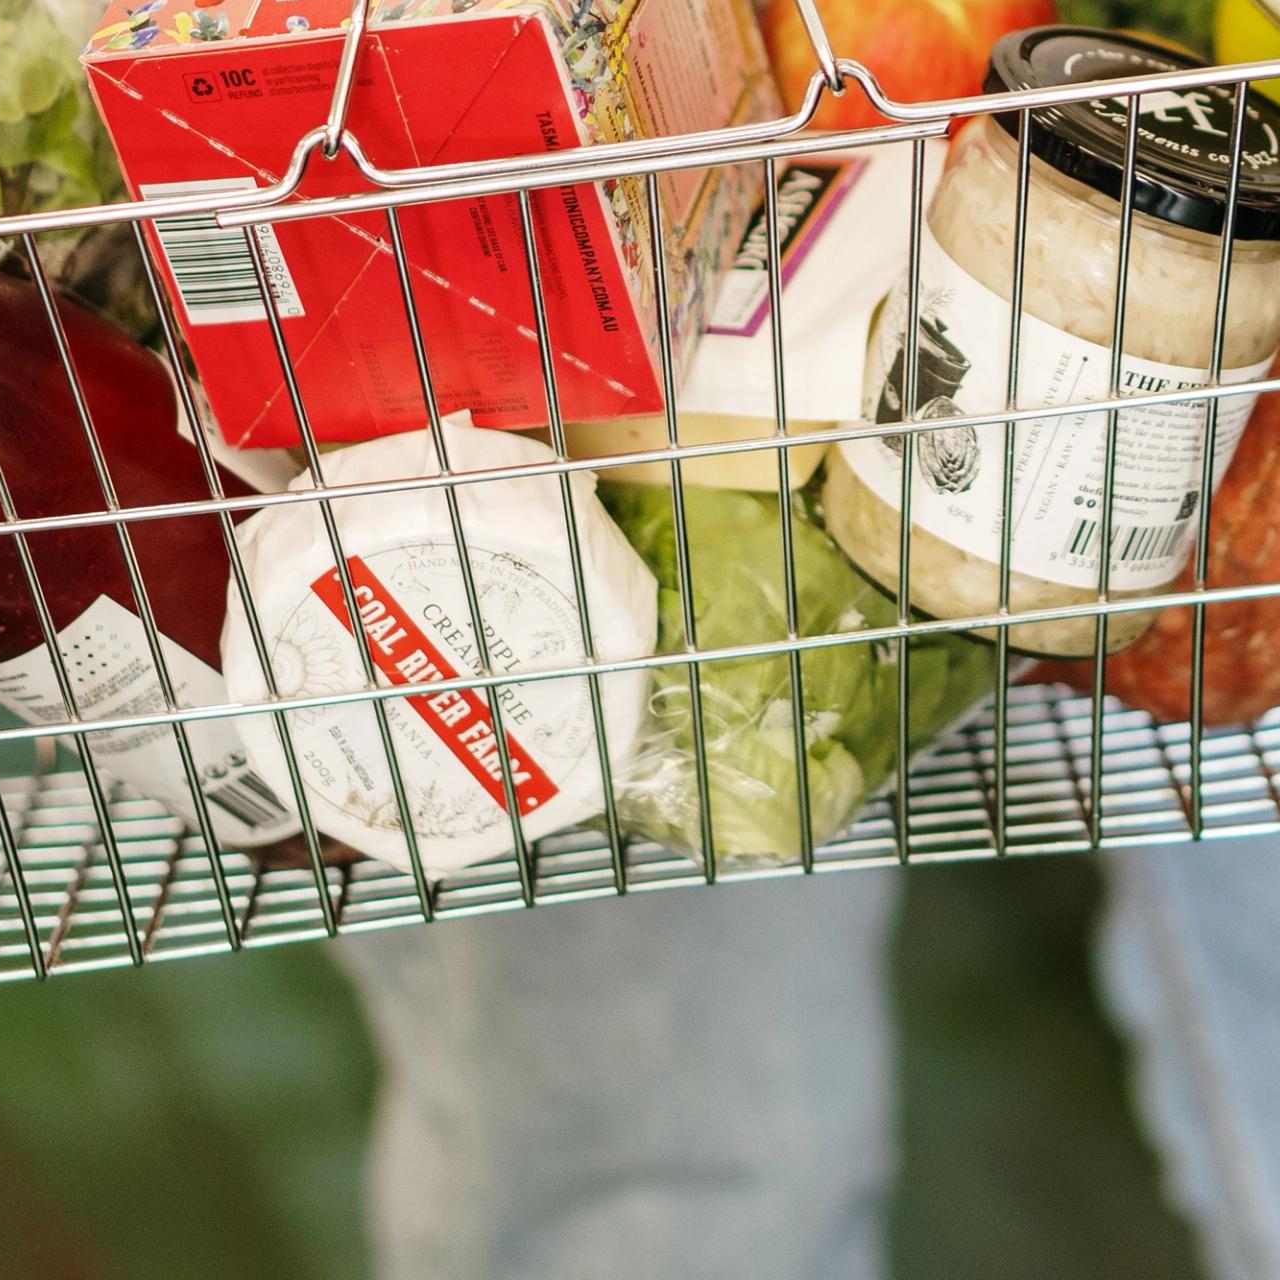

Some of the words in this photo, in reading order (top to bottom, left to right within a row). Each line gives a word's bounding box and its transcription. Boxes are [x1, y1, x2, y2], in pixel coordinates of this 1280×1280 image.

[219, 68, 257, 88] 10C
[228, 88, 264, 100] REFUND
[1094, 109, 1200, 157] fements
[536, 110, 620, 332] TASMTONICCOMPANY.COM.AU
[1016, 383, 1058, 473] PRESERVIVE
[1053, 352, 1072, 383] FREE
[1035, 482, 1059, 521] VEGAN
[1057, 442, 1074, 470] RAW
[1073, 394, 1095, 430] ALE
[1078, 484, 1180, 504] thefementary.com.au
[408, 557, 447, 571] HAND
[451, 557, 487, 570] MDE
[505, 569, 531, 590] THE
[468, 613, 524, 686] RIPL
[348, 585, 408, 656] COAL
[395, 648, 472, 728] RIVER
[457, 720, 532, 787] FARM
[303, 751, 337, 788] 200g
